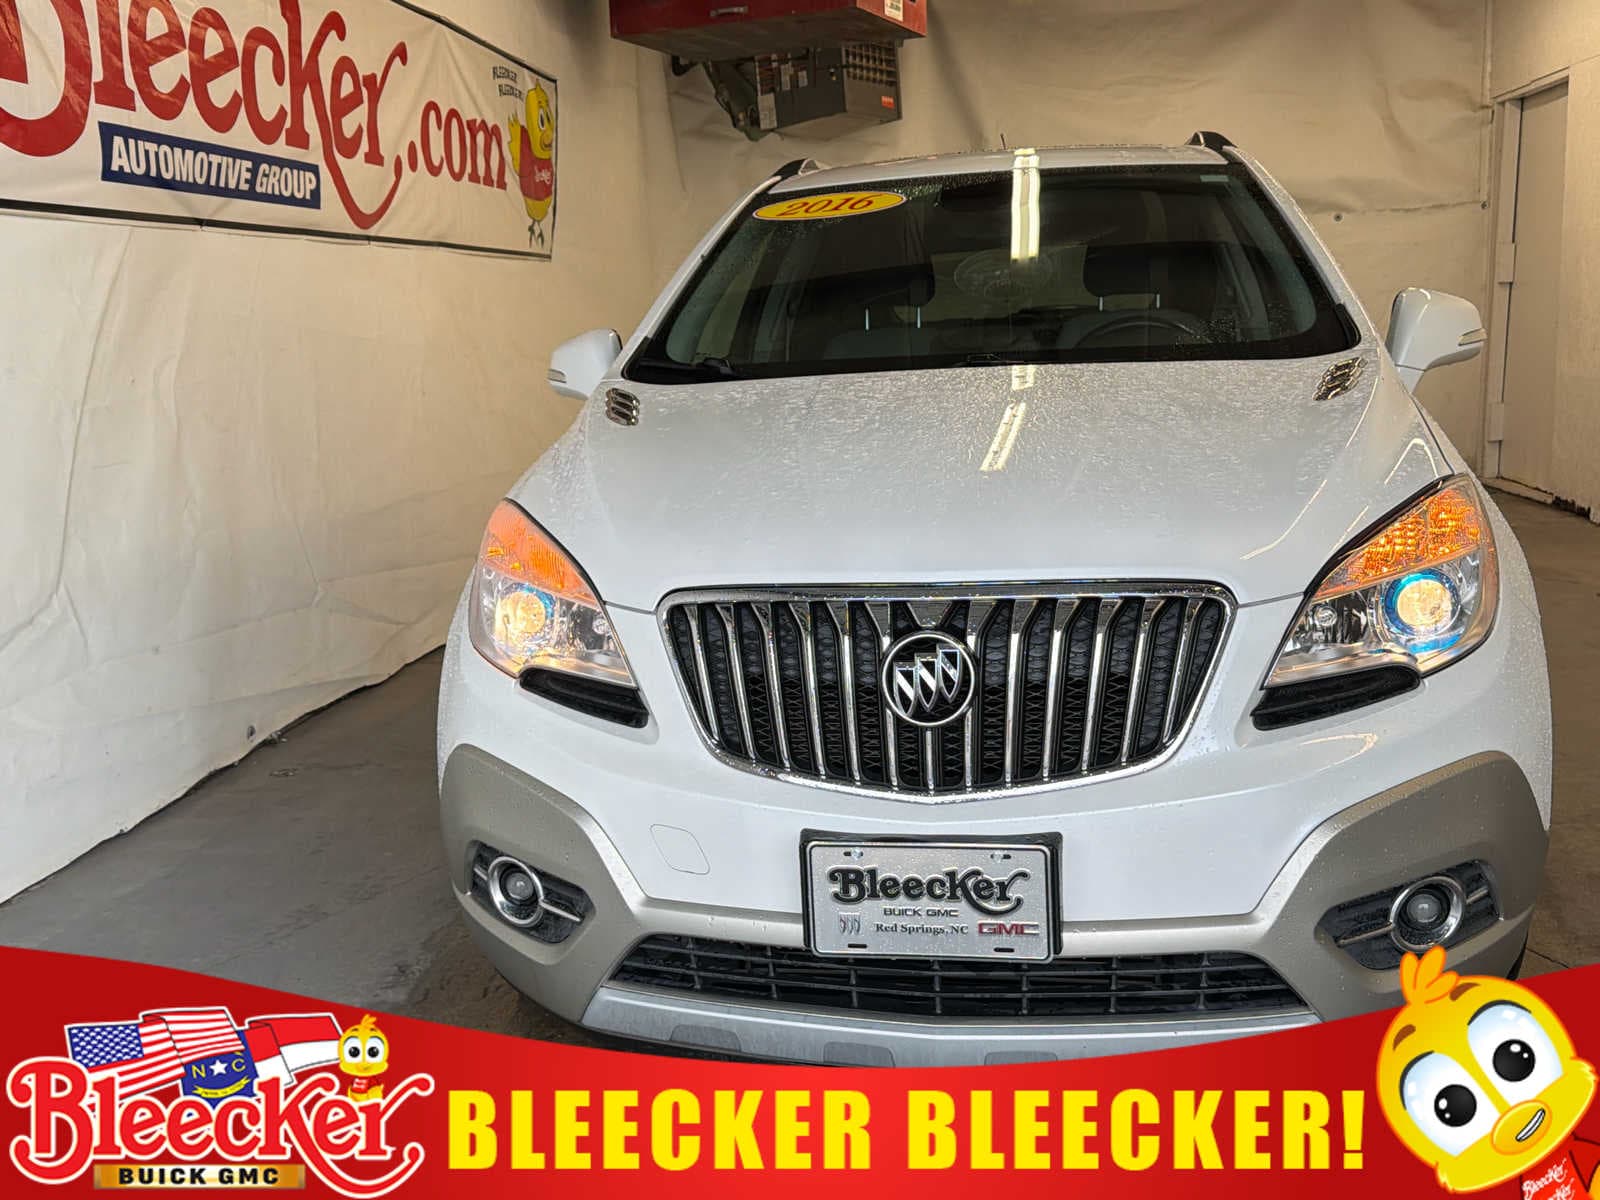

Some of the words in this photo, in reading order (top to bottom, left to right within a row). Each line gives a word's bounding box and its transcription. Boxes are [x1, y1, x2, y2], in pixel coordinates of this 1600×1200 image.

[110, 135, 253, 191] AUTOMOTIVE
[255, 163, 317, 200] GROUP
[776, 193, 885, 217] 2016
[883, 906, 922, 918] BUICK
[926, 908, 960, 918] GMC
[875, 922, 899, 934] Red
[899, 922, 949, 937] Springs,
[950, 924, 969, 935] NC
[977, 921, 1040, 936] GMC
